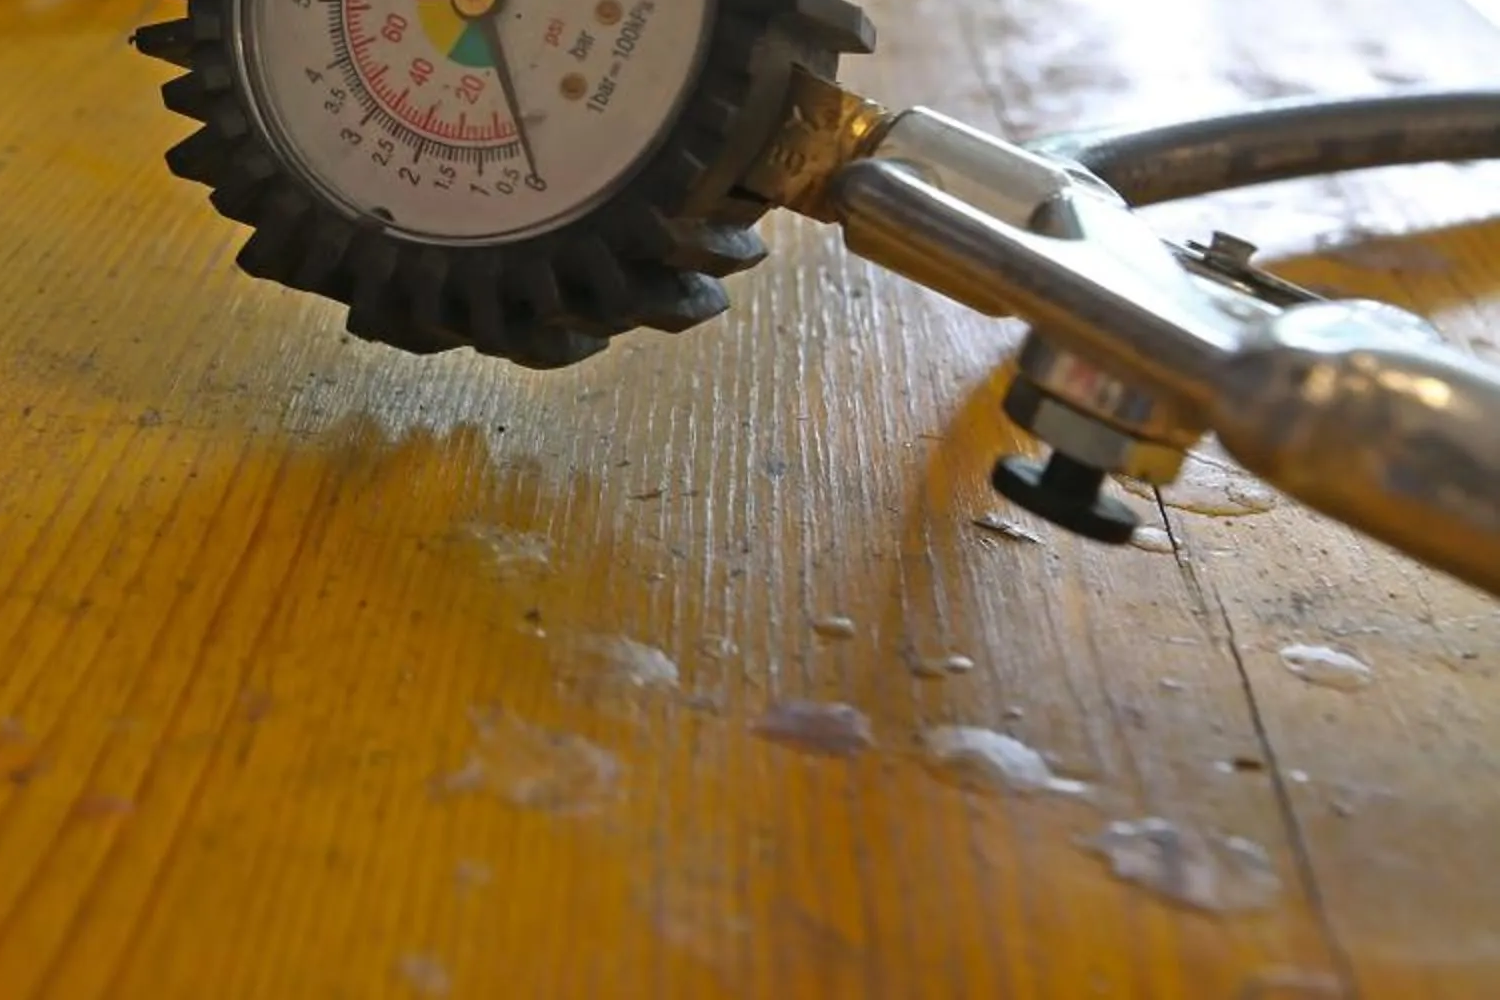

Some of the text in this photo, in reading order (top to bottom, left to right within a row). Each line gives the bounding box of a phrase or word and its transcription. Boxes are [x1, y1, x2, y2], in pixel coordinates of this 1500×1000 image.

[381, 13, 407, 43] 60
[545, 18, 564, 47] psi
[567, 29, 595, 62] bar
[305, 67, 323, 85] 4
[409, 58, 434, 86] 40
[455, 74, 485, 105] 20
[340, 128, 363, 145] 3
[398, 167, 420, 186] 2
[524, 172, 547, 192] 0
[470, 182, 490, 197] 1
